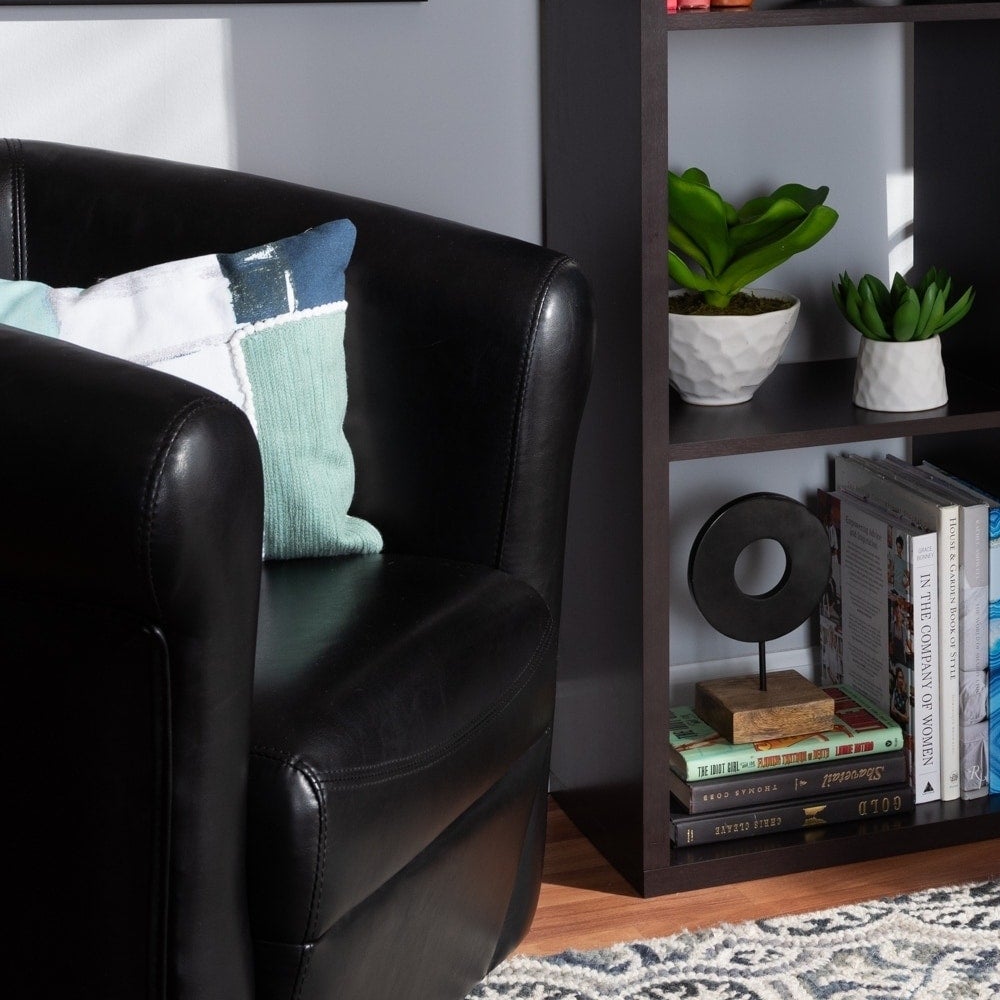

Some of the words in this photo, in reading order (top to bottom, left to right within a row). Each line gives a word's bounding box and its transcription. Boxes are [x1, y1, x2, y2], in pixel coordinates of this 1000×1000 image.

[919, 573, 931, 589] IN
[919, 592, 932, 621] THE
[920, 624, 933, 689] COMPANY
[921, 693, 933, 711] OF
[921, 713, 934, 767] WOMEN
[697, 765, 709, 778] THE
[710, 762, 726, 776] IDIOT
[727, 760, 740, 773] GIRL
[821, 765, 885, 788] Shavetail
[734, 784, 778, 797] THOMAS
[858, 795, 902, 816] GOLD
[714, 821, 751, 836] CLEAVE
[753, 817, 782, 829] CHRIS
